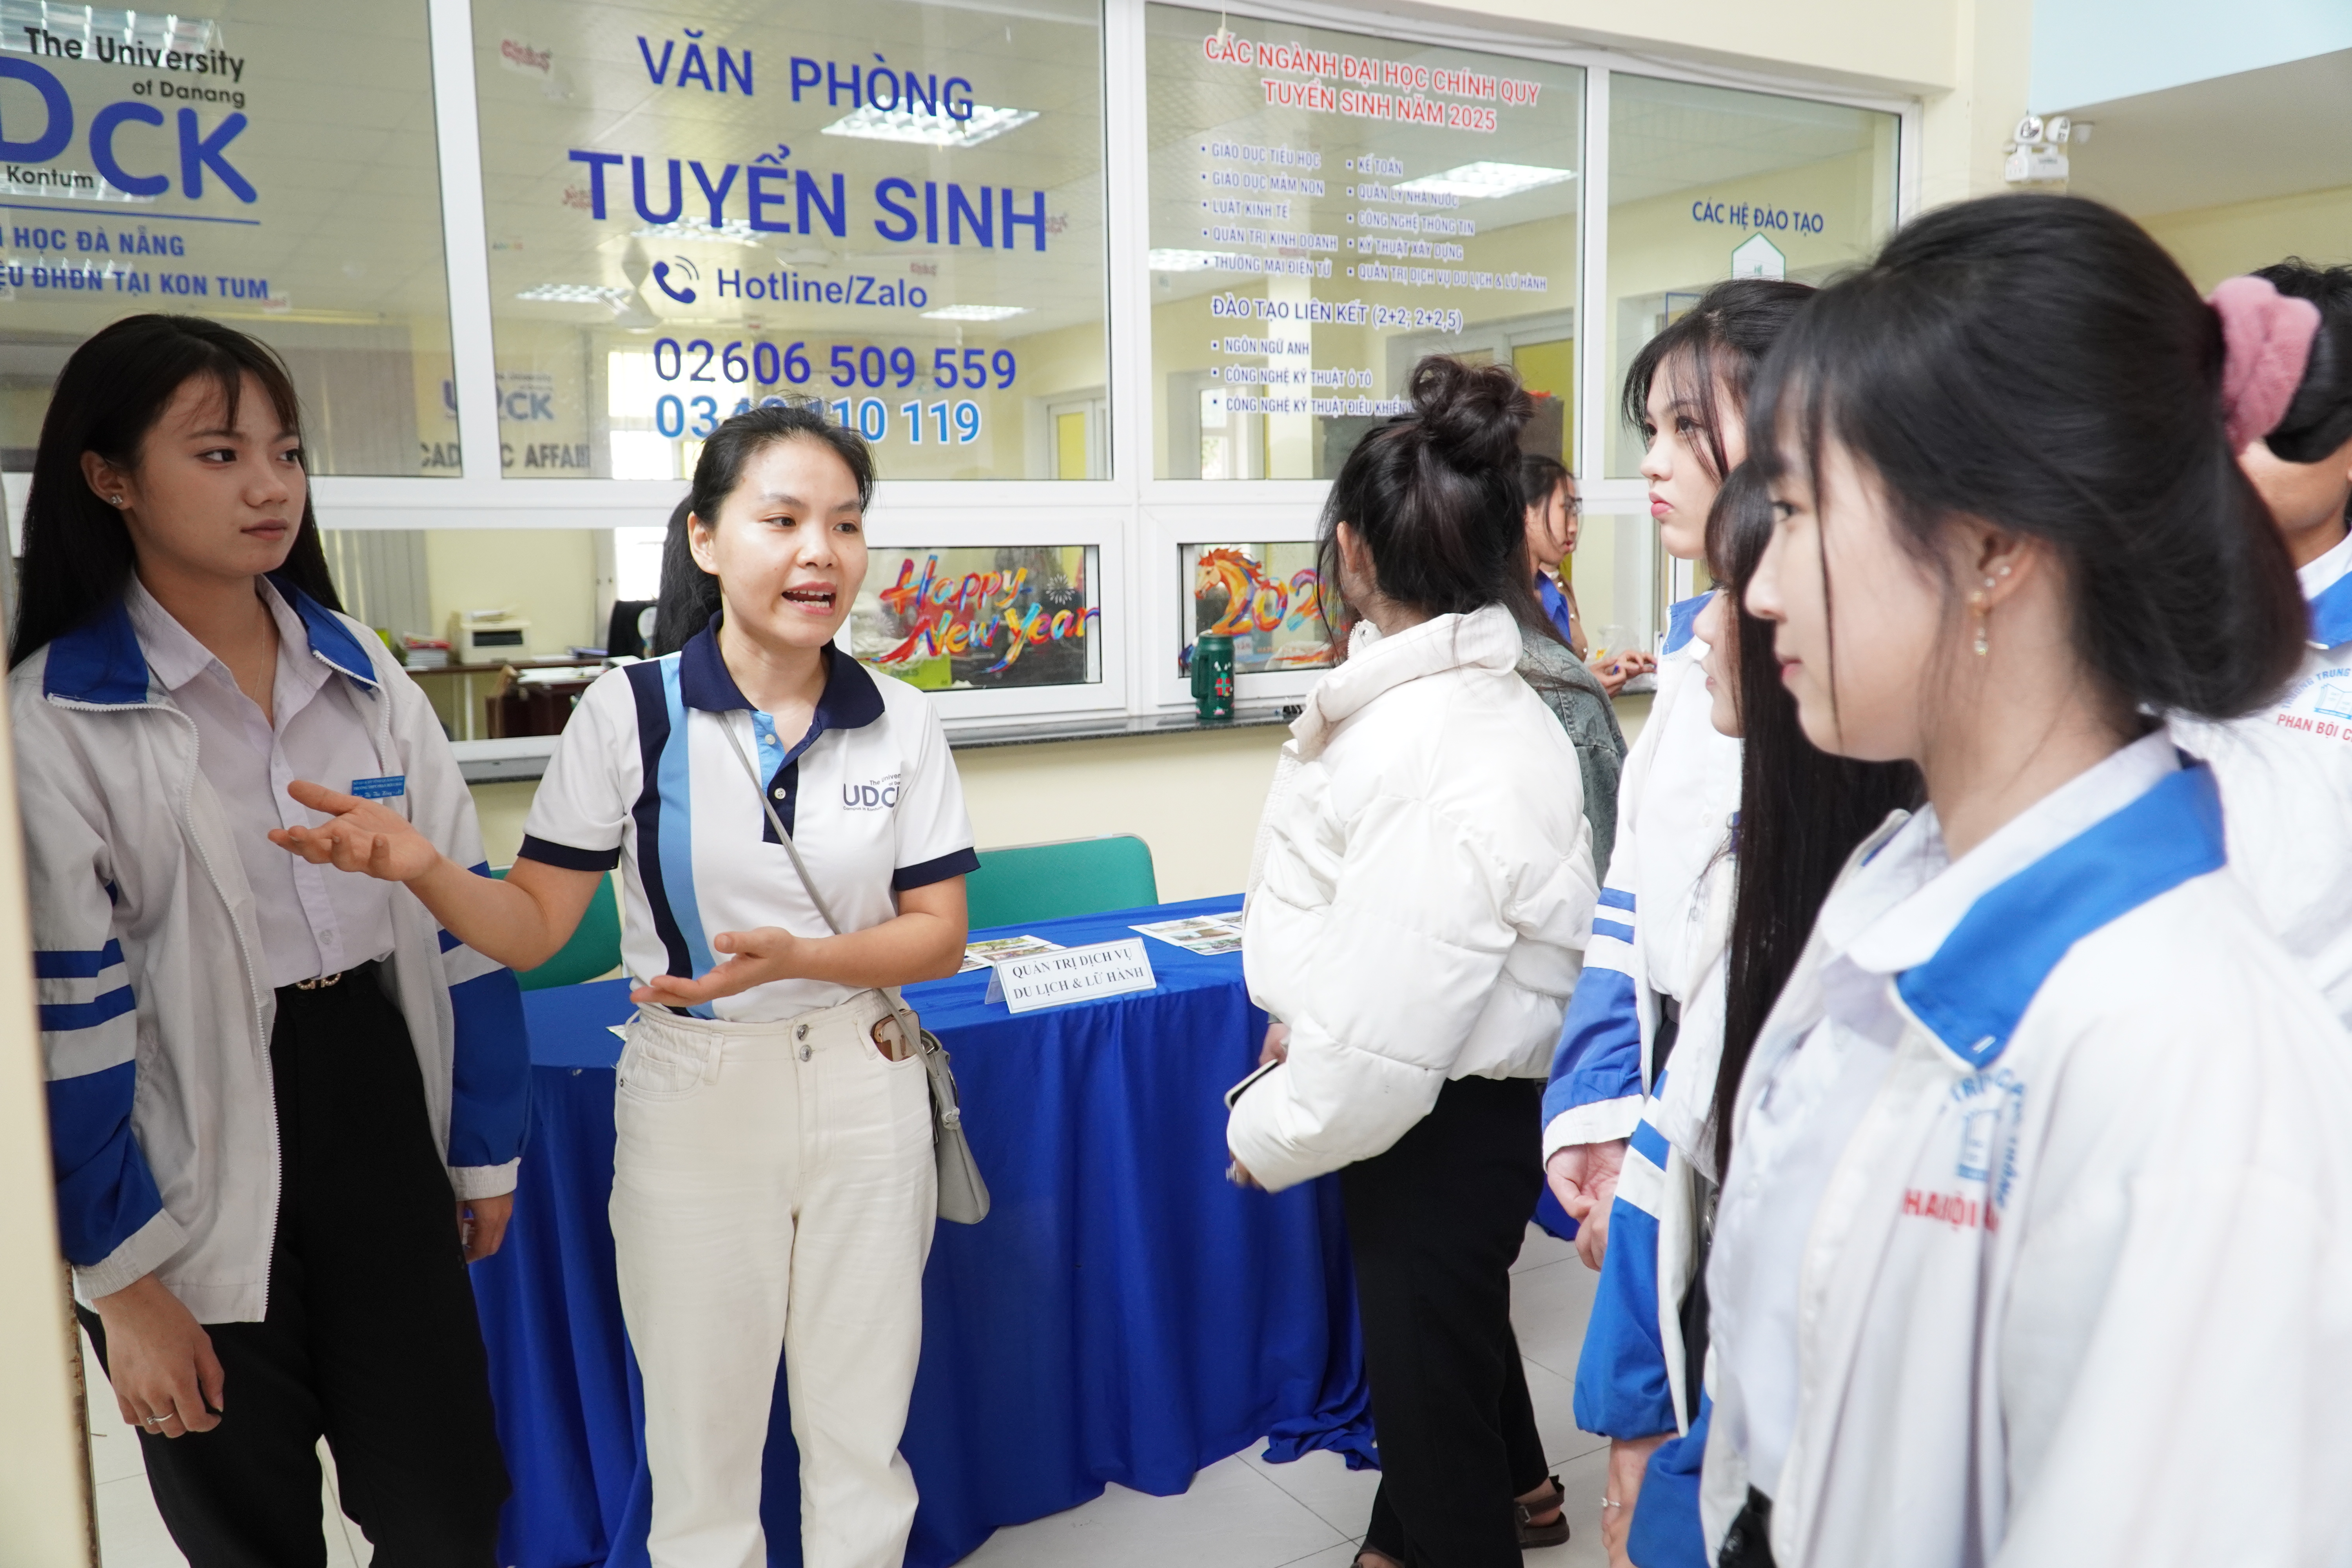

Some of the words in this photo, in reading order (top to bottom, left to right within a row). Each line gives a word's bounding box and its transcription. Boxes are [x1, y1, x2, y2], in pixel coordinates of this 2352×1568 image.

[24, 26, 82, 59] The
[95, 36, 245, 81] University
[637, 27, 753, 96] VĂN
[790, 52, 974, 122] PHÒNG
[1205, 34, 1251, 64] CÁC
[1259, 41, 1337, 76] NGÀNH
[1343, 57, 1377, 86] ĐẠI
[1385, 62, 1427, 91] HỌC
[1434, 68, 1495, 98] CHÍNH
[1501, 80, 1541, 105] QUY
[132, 80, 152, 96] of
[160, 81, 245, 108] Danang
[1263, 79, 1334, 109] TUYỂN
[1341, 91, 1390, 117] SINH
[1397, 96, 1444, 124] NĂM
[1449, 105, 1496, 131] 2025
[1212, 141, 1240, 159] GIÁO
[1242, 145, 1267, 165] DỤC
[1296, 151, 1321, 170] HỌC
[7, 165, 94, 189] Kontum
[1212, 168, 1241, 187] GIÁO
[1242, 174, 1268, 192] DỤC
[1299, 178, 1325, 196] NON
[568, 143, 847, 238] TUYỂN
[874, 177, 1046, 252] SINH
[1212, 197, 1242, 218] LUẬT
[1245, 201, 1274, 218] KINH
[1275, 199, 1291, 220] TẾ
[1357, 208, 1388, 227] CÔNG
[1390, 212, 1419, 234] NGHỆ
[1421, 214, 1456, 234] THÔNG
[1457, 219, 1475, 236] TIN
[1692, 196, 1724, 224] CÁC
[1730, 201, 1749, 231] HỆ
[1754, 203, 1788, 230] ĐÀO
[1793, 211, 1824, 237] TẠO
[13, 227, 66, 254] HỌC
[76, 225, 110, 252] ĐÀ
[1212, 223, 1246, 244] QUẢN
[1247, 229, 1267, 249] TRỊ
[1269, 230, 1297, 247] KINH
[1299, 233, 1338, 252] DOANH
[1375, 237, 1409, 259] THUẬT
[1411, 239, 1432, 258] XÂY
[31, 267, 102, 290] ĐHĐN
[113, 271, 150, 297] TẠI
[160, 273, 207, 296] KON
[216, 276, 269, 299] TUM
[1263, 258, 1286, 277] MẠI
[1357, 261, 1389, 281] QUẢN
[1390, 266, 1408, 285] TRỊ
[1409, 267, 1435, 287] DỊCH
[1436, 269, 1452, 289] VỤ
[1452, 270, 1468, 287] DU
[1469, 271, 1493, 290] LỊCH
[1494, 273, 1503, 289] &
[1519, 273, 1548, 292] HÀNH
[717, 269, 927, 308] Hotline/Zalo
[1212, 293, 1250, 317] ĐÀO
[1254, 299, 1289, 321] TẠO
[1295, 298, 1332, 321] LIÊN
[1336, 299, 1368, 324] KẾT
[1372, 305, 1411, 329] (2+2;
[1416, 308, 1463, 334] 2+2,5)
[1225, 335, 1257, 354] NGÔN
[1259, 338, 1285, 355] NGỮ
[1287, 341, 1310, 356] ANH
[654, 338, 811, 385] 02606
[830, 345, 915, 388] 509
[933, 348, 1016, 389] 559
[1225, 364, 1258, 384] CÔNG
[1259, 367, 1289, 388] NGHỆ
[1311, 367, 1346, 390] THUẬT
[1347, 368, 1357, 388] Ô
[1358, 368, 1373, 388] TÔ
[902, 399, 980, 443] 119
[1226, 393, 1258, 413] CÔNG
[1259, 397, 1289, 418] NGHỆ
[1311, 396, 1346, 418] THUẬT
[1347, 394, 1372, 416] ĐIỀU
[880, 554, 1031, 614] Happy
[858, 610, 1000, 663] New
[978, 602, 1099, 673] Year
[2316, 668, 2351, 681] TRUNG
[2276, 713, 2314, 732] PHAN
[2316, 721, 2339, 739] BỘI
[1013, 960, 1051, 979] QUẢN
[1053, 957, 1077, 970] TRỊ
[1080, 951, 1112, 967] DỊCH
[1114, 948, 1133, 960] VỤ
[1013, 986, 1032, 999] DU
[1036, 980, 1069, 996] LỊCH
[1072, 978, 1083, 989] &
[1085, 972, 1103, 987] LỮ
[1106, 967, 1145, 982] HÀNH
